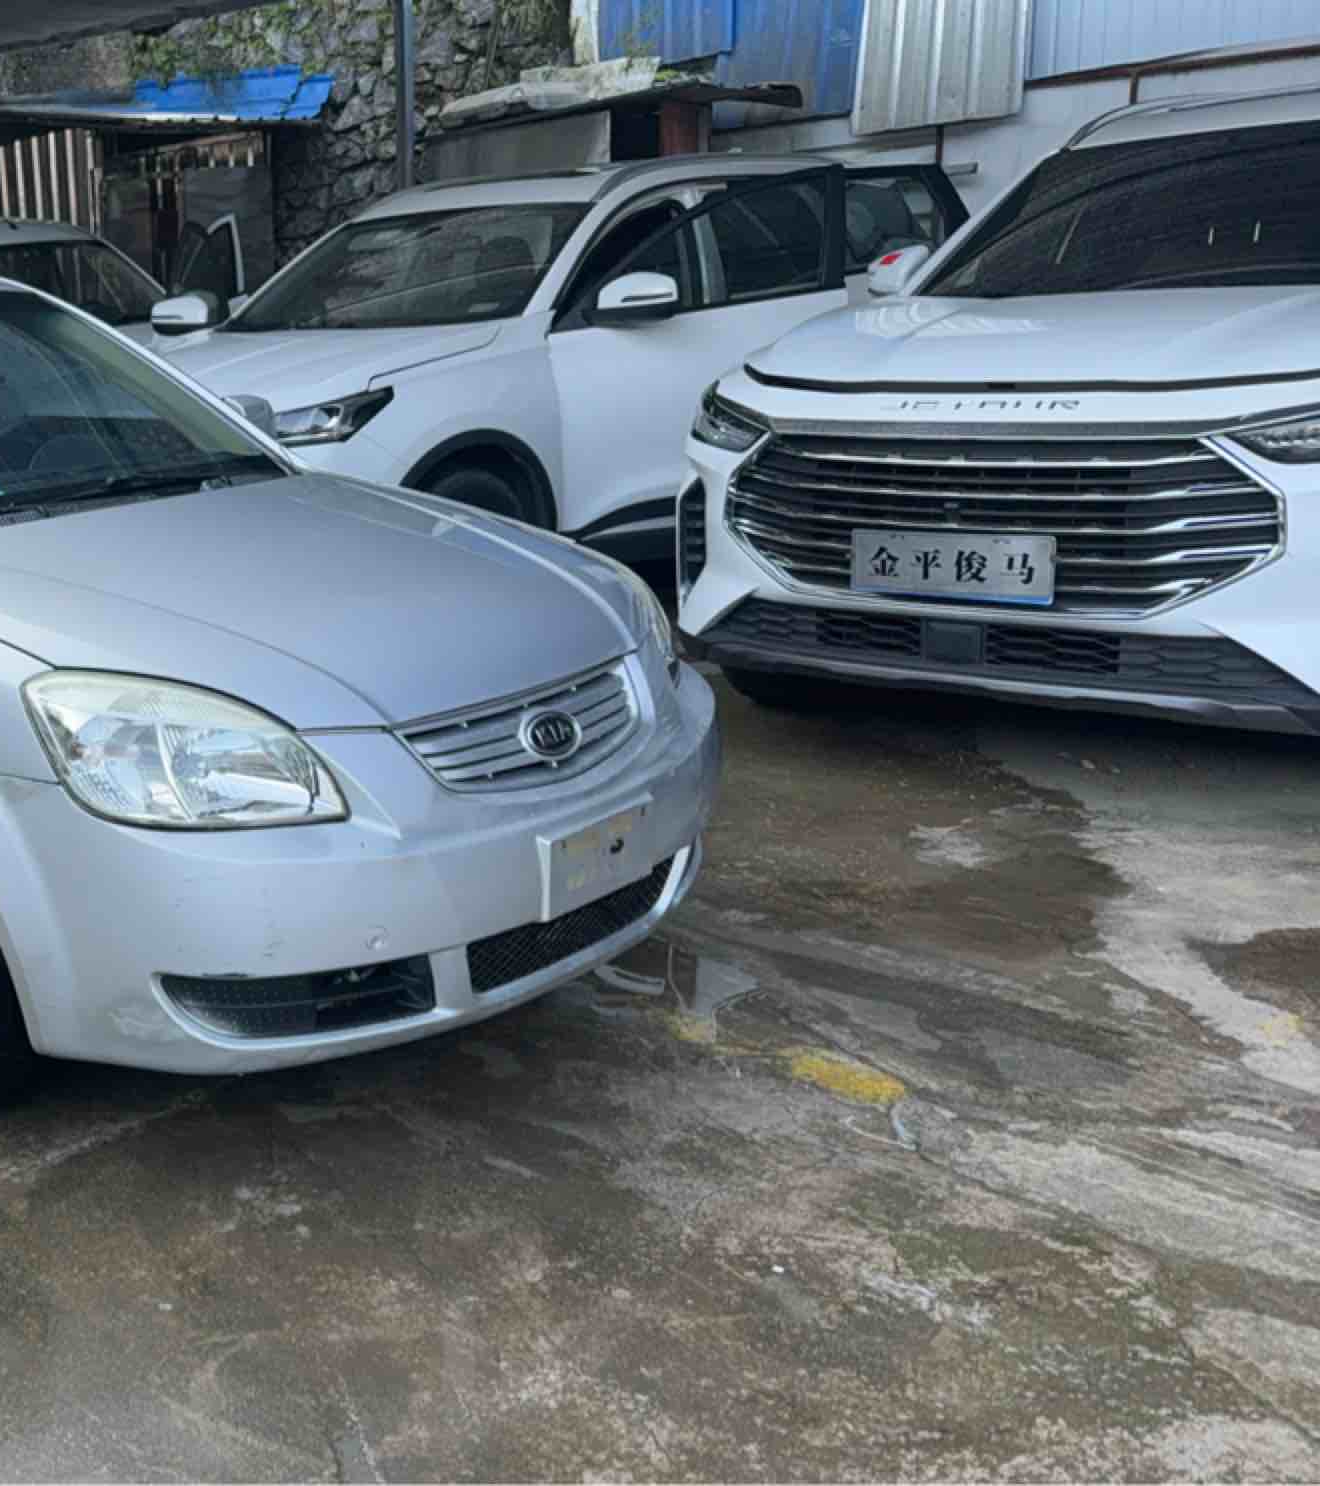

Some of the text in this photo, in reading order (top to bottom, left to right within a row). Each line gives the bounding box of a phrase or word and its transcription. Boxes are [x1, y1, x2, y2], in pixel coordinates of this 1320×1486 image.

[870, 546, 1036, 584] 金平俊马
[535, 719, 571, 747] KIA
